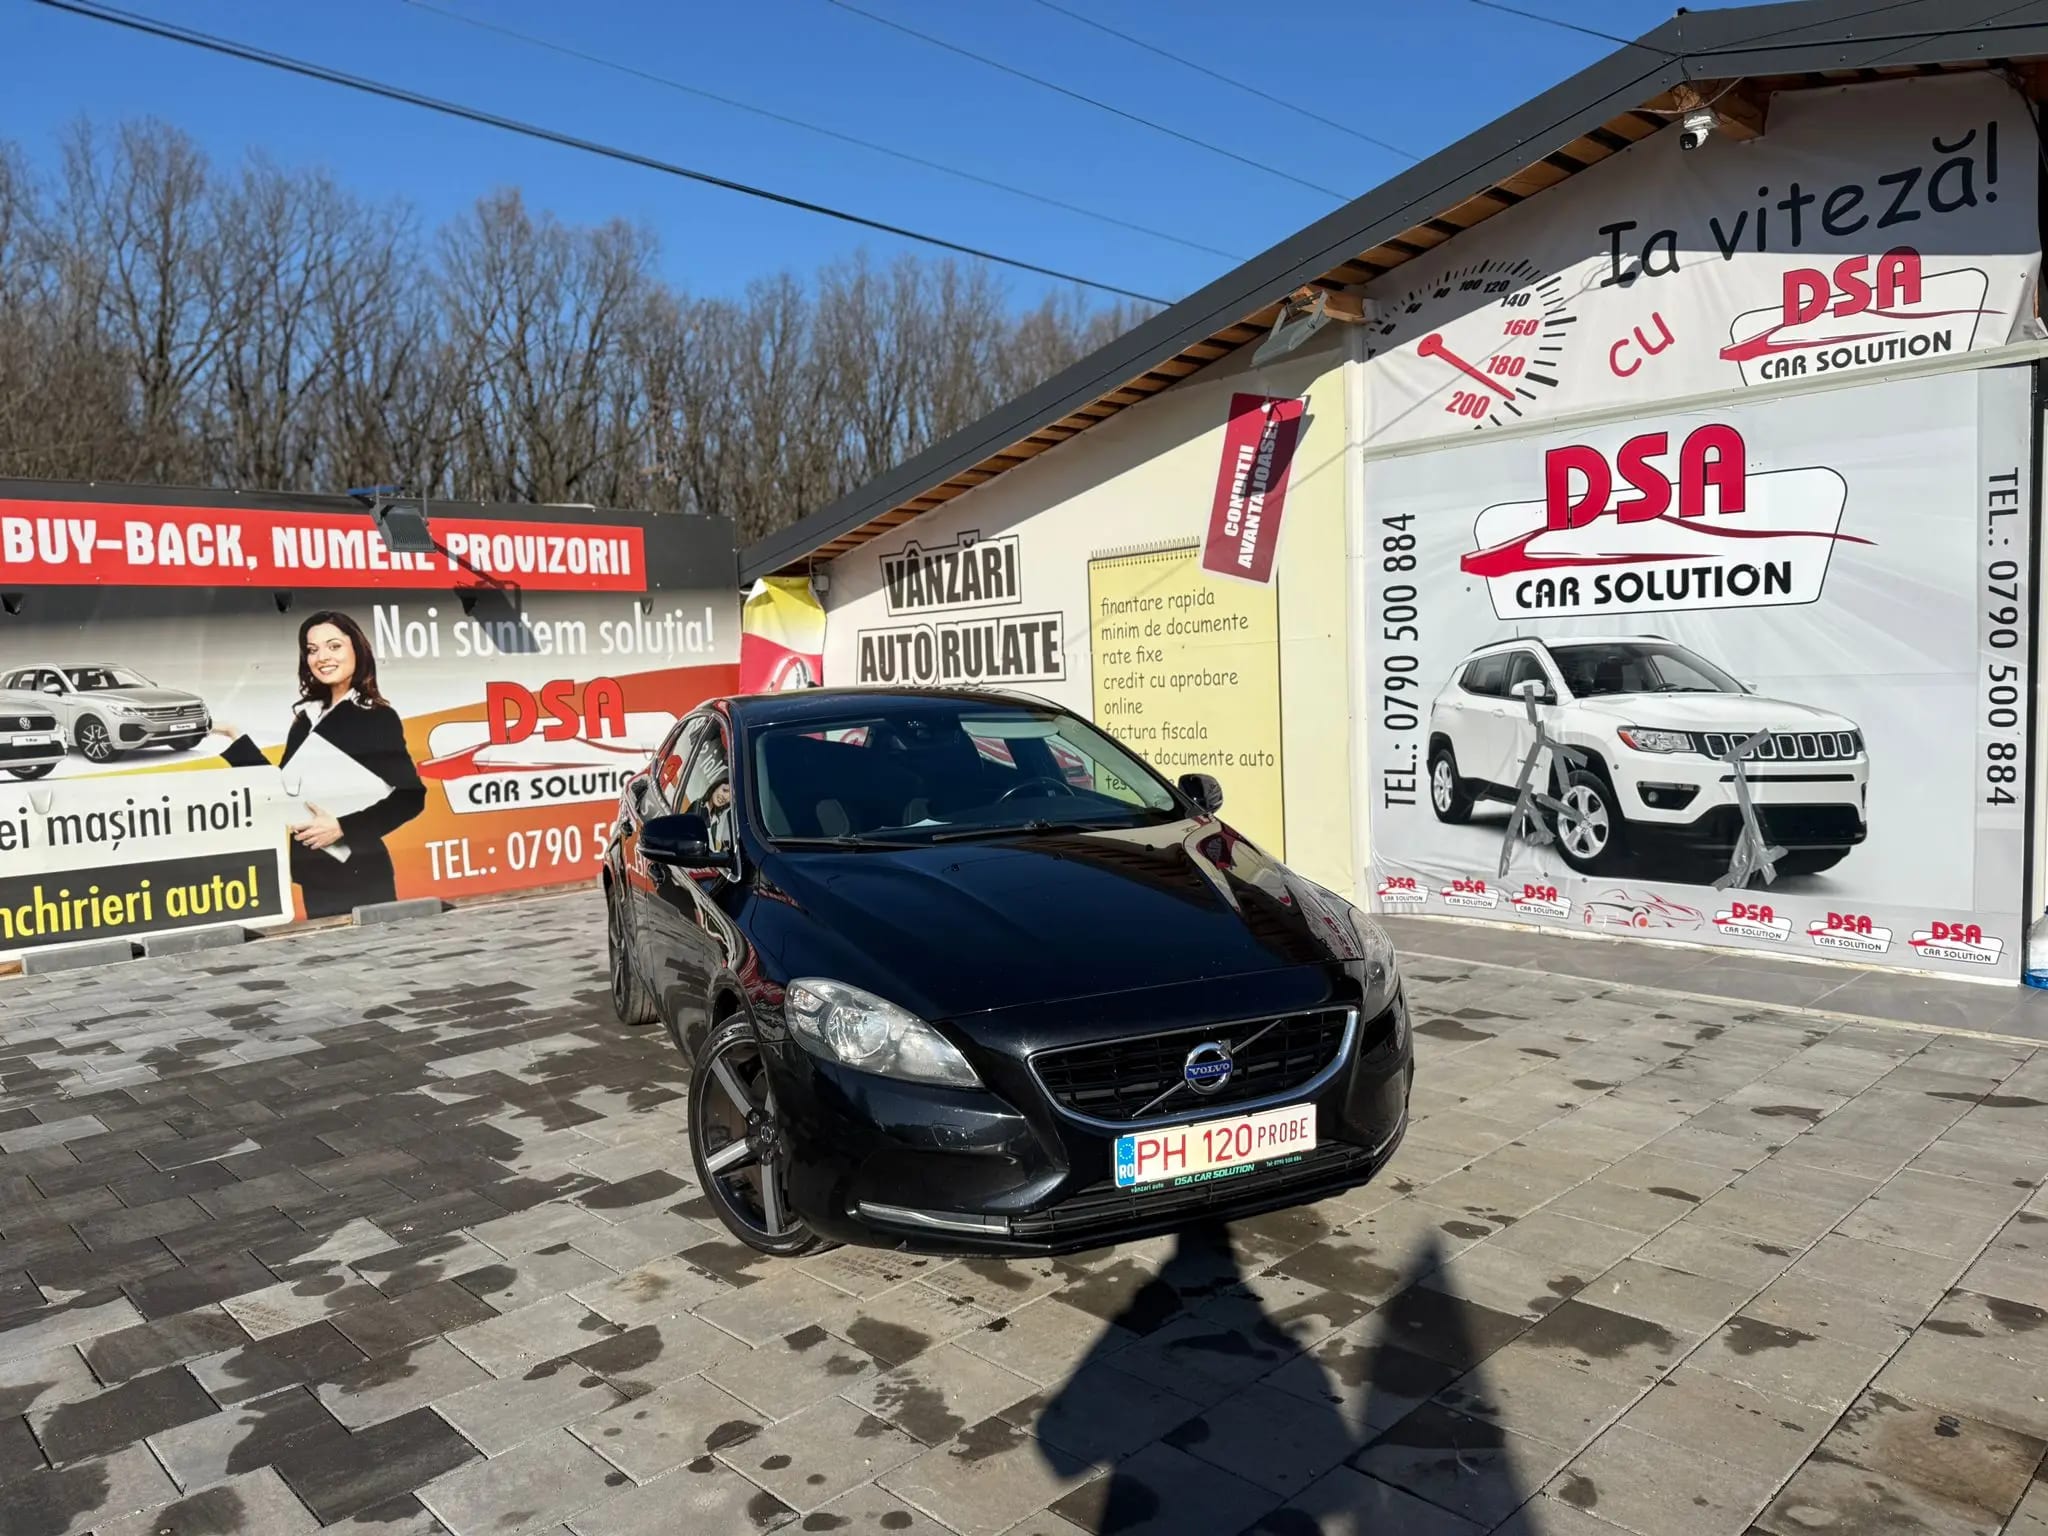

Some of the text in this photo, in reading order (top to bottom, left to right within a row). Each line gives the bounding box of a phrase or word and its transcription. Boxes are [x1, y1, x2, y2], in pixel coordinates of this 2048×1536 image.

[1599, 120, 1998, 288] Ia viteză!
[1459, 280, 1482, 291] 100
[1483, 280, 1510, 293] 120
[1783, 245, 1922, 327] DSA
[1500, 293, 1531, 308] 140
[1503, 319, 1539, 336] 160
[1609, 311, 1675, 377] cu
[1760, 330, 1952, 381] CAR SOLUTION
[1487, 355, 1526, 377] 180
[1445, 391, 1490, 420] 200
[1545, 423, 1747, 532] DSA
[1224, 445, 1254, 537] CONDITII
[1, 517, 257, 570] BUY-BACK,
[446, 533, 630, 576] PROVIZORII
[885, 537, 1016, 610] VÂNZĂRI
[1515, 561, 1792, 609] CAR SOLUTION
[1101, 587, 1215, 616] finantare rapida
[373, 602, 716, 661] Noi suntem soluția!
[1101, 614, 1249, 640] minim de documente
[1986, 467, 2019, 806] TEL.: 0790 500 884
[860, 620, 1061, 683] AUTO RULATE
[1102, 645, 1164, 665] rate fixe
[1382, 513, 1419, 808] TEL.: 0790 500 884
[1103, 667, 1239, 692] credit cu aprobare
[486, 677, 627, 745] DSA
[1104, 697, 1144, 715] online
[1162, 720, 1208, 741] fiscala
[1154, 747, 1234, 767] documente
[1239, 749, 1274, 767] auto
[469, 770, 636, 805] CAR SOLUTIO
[1105, 775, 1122, 790] tes
[47, 795, 172, 851] mașini
[187, 787, 253, 833] noi!
[425, 838, 497, 881] TEL.:
[507, 826, 582, 870] 0790
[166, 865, 259, 919] auto!
[1387, 876, 1416, 889] DSA
[1452, 879, 1486, 894] DSA
[1523, 883, 1557, 902] DSA
[1462, 899, 1492, 907] SOLUTION
[1533, 906, 1565, 916] SOLUTION
[1732, 902, 1774, 923] DSA
[1724, 926, 1782, 940] CAR SOLUTION
[1827, 911, 1873, 934] DSA
[1932, 921, 1982, 944] DSA
[1819, 937, 1882, 951] CAR SOLUTION
[1923, 947, 1992, 963] CAR SOLUTION
[1188, 1062, 1230, 1075] VOLVO
[1119, 1117, 1309, 1179] RO PH 120 PROBE
[1194, 1172, 1212, 1182] CAR
[1213, 1163, 1255, 1179] SOLUTION
